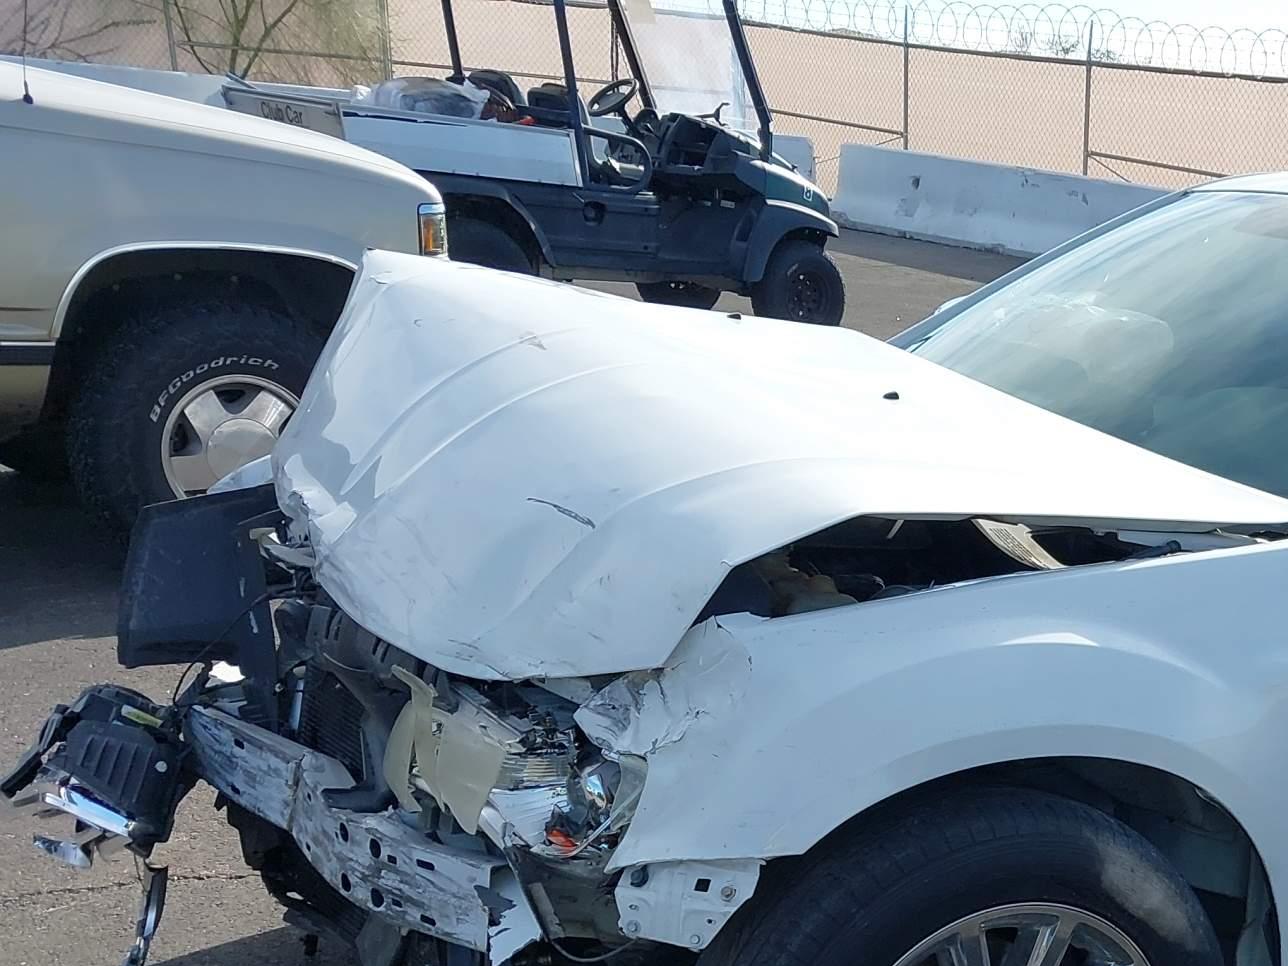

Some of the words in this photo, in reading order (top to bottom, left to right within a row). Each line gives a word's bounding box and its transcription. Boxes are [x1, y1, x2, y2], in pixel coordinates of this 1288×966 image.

[260, 102, 285, 121] Club
[285, 105, 304, 125] Car
[150, 355, 279, 422] BFGoodrich
